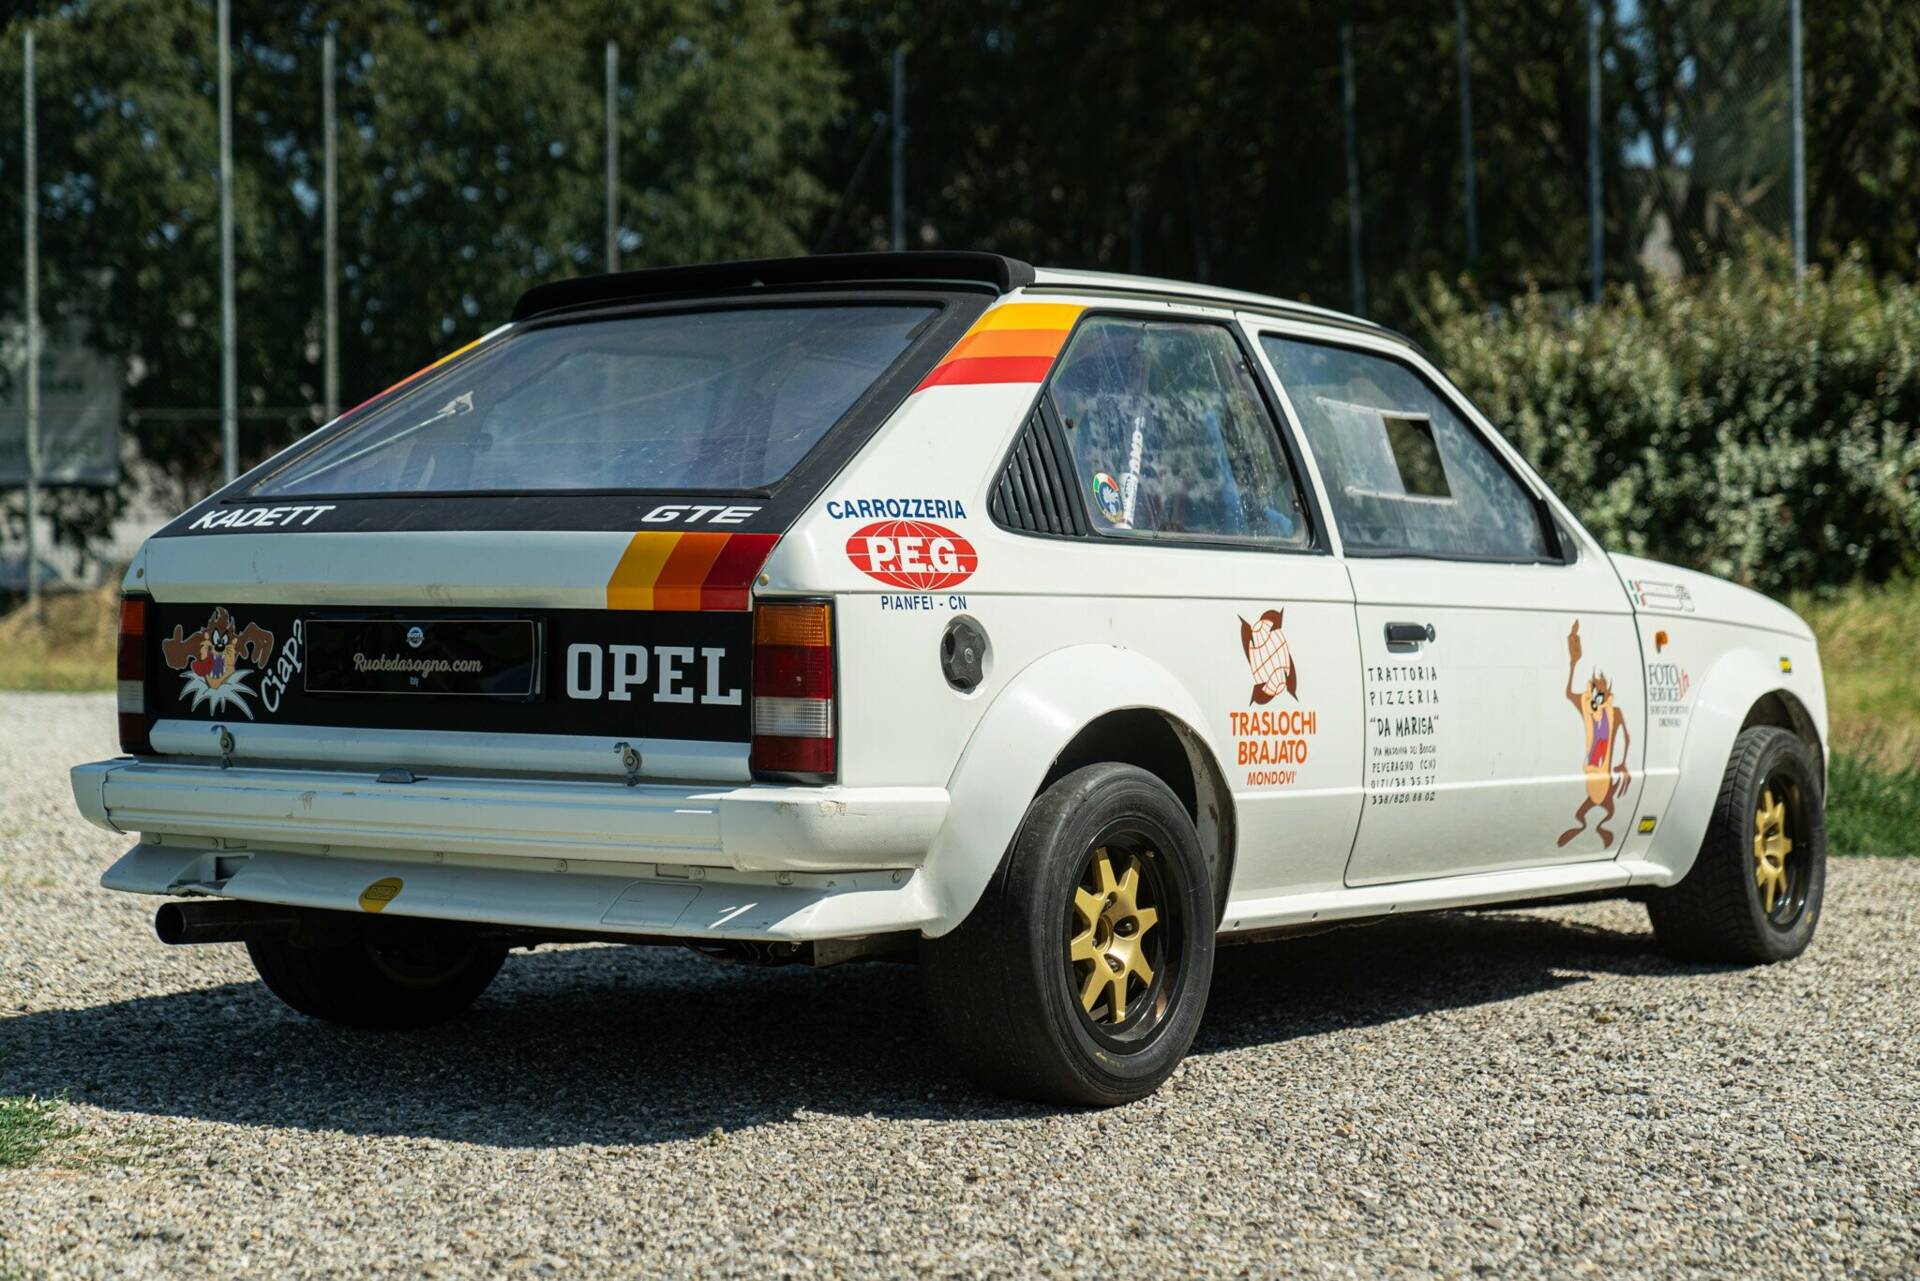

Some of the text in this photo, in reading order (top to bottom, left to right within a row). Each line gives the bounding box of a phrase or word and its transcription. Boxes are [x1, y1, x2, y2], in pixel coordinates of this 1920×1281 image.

[188, 505, 336, 529] KADETT
[641, 505, 762, 523] GTE
[826, 498, 967, 520] CARROZZERIA
[866, 536, 967, 573] P.E.G.
[881, 595, 934, 610] PIANFEI
[949, 595, 967, 610] CN
[353, 653, 483, 678] Ruotedasogno.com
[566, 643, 742, 706] OPEL
[1368, 666, 1438, 682] TRATTORIA
[1648, 663, 1679, 686] FOTO
[1370, 689, 1439, 706] PIZZERIA
[1230, 711, 1316, 736] TRASLOCHI
[1238, 740, 1307, 765] BRAJATO
[1247, 771, 1297, 786] MONDOVI'
